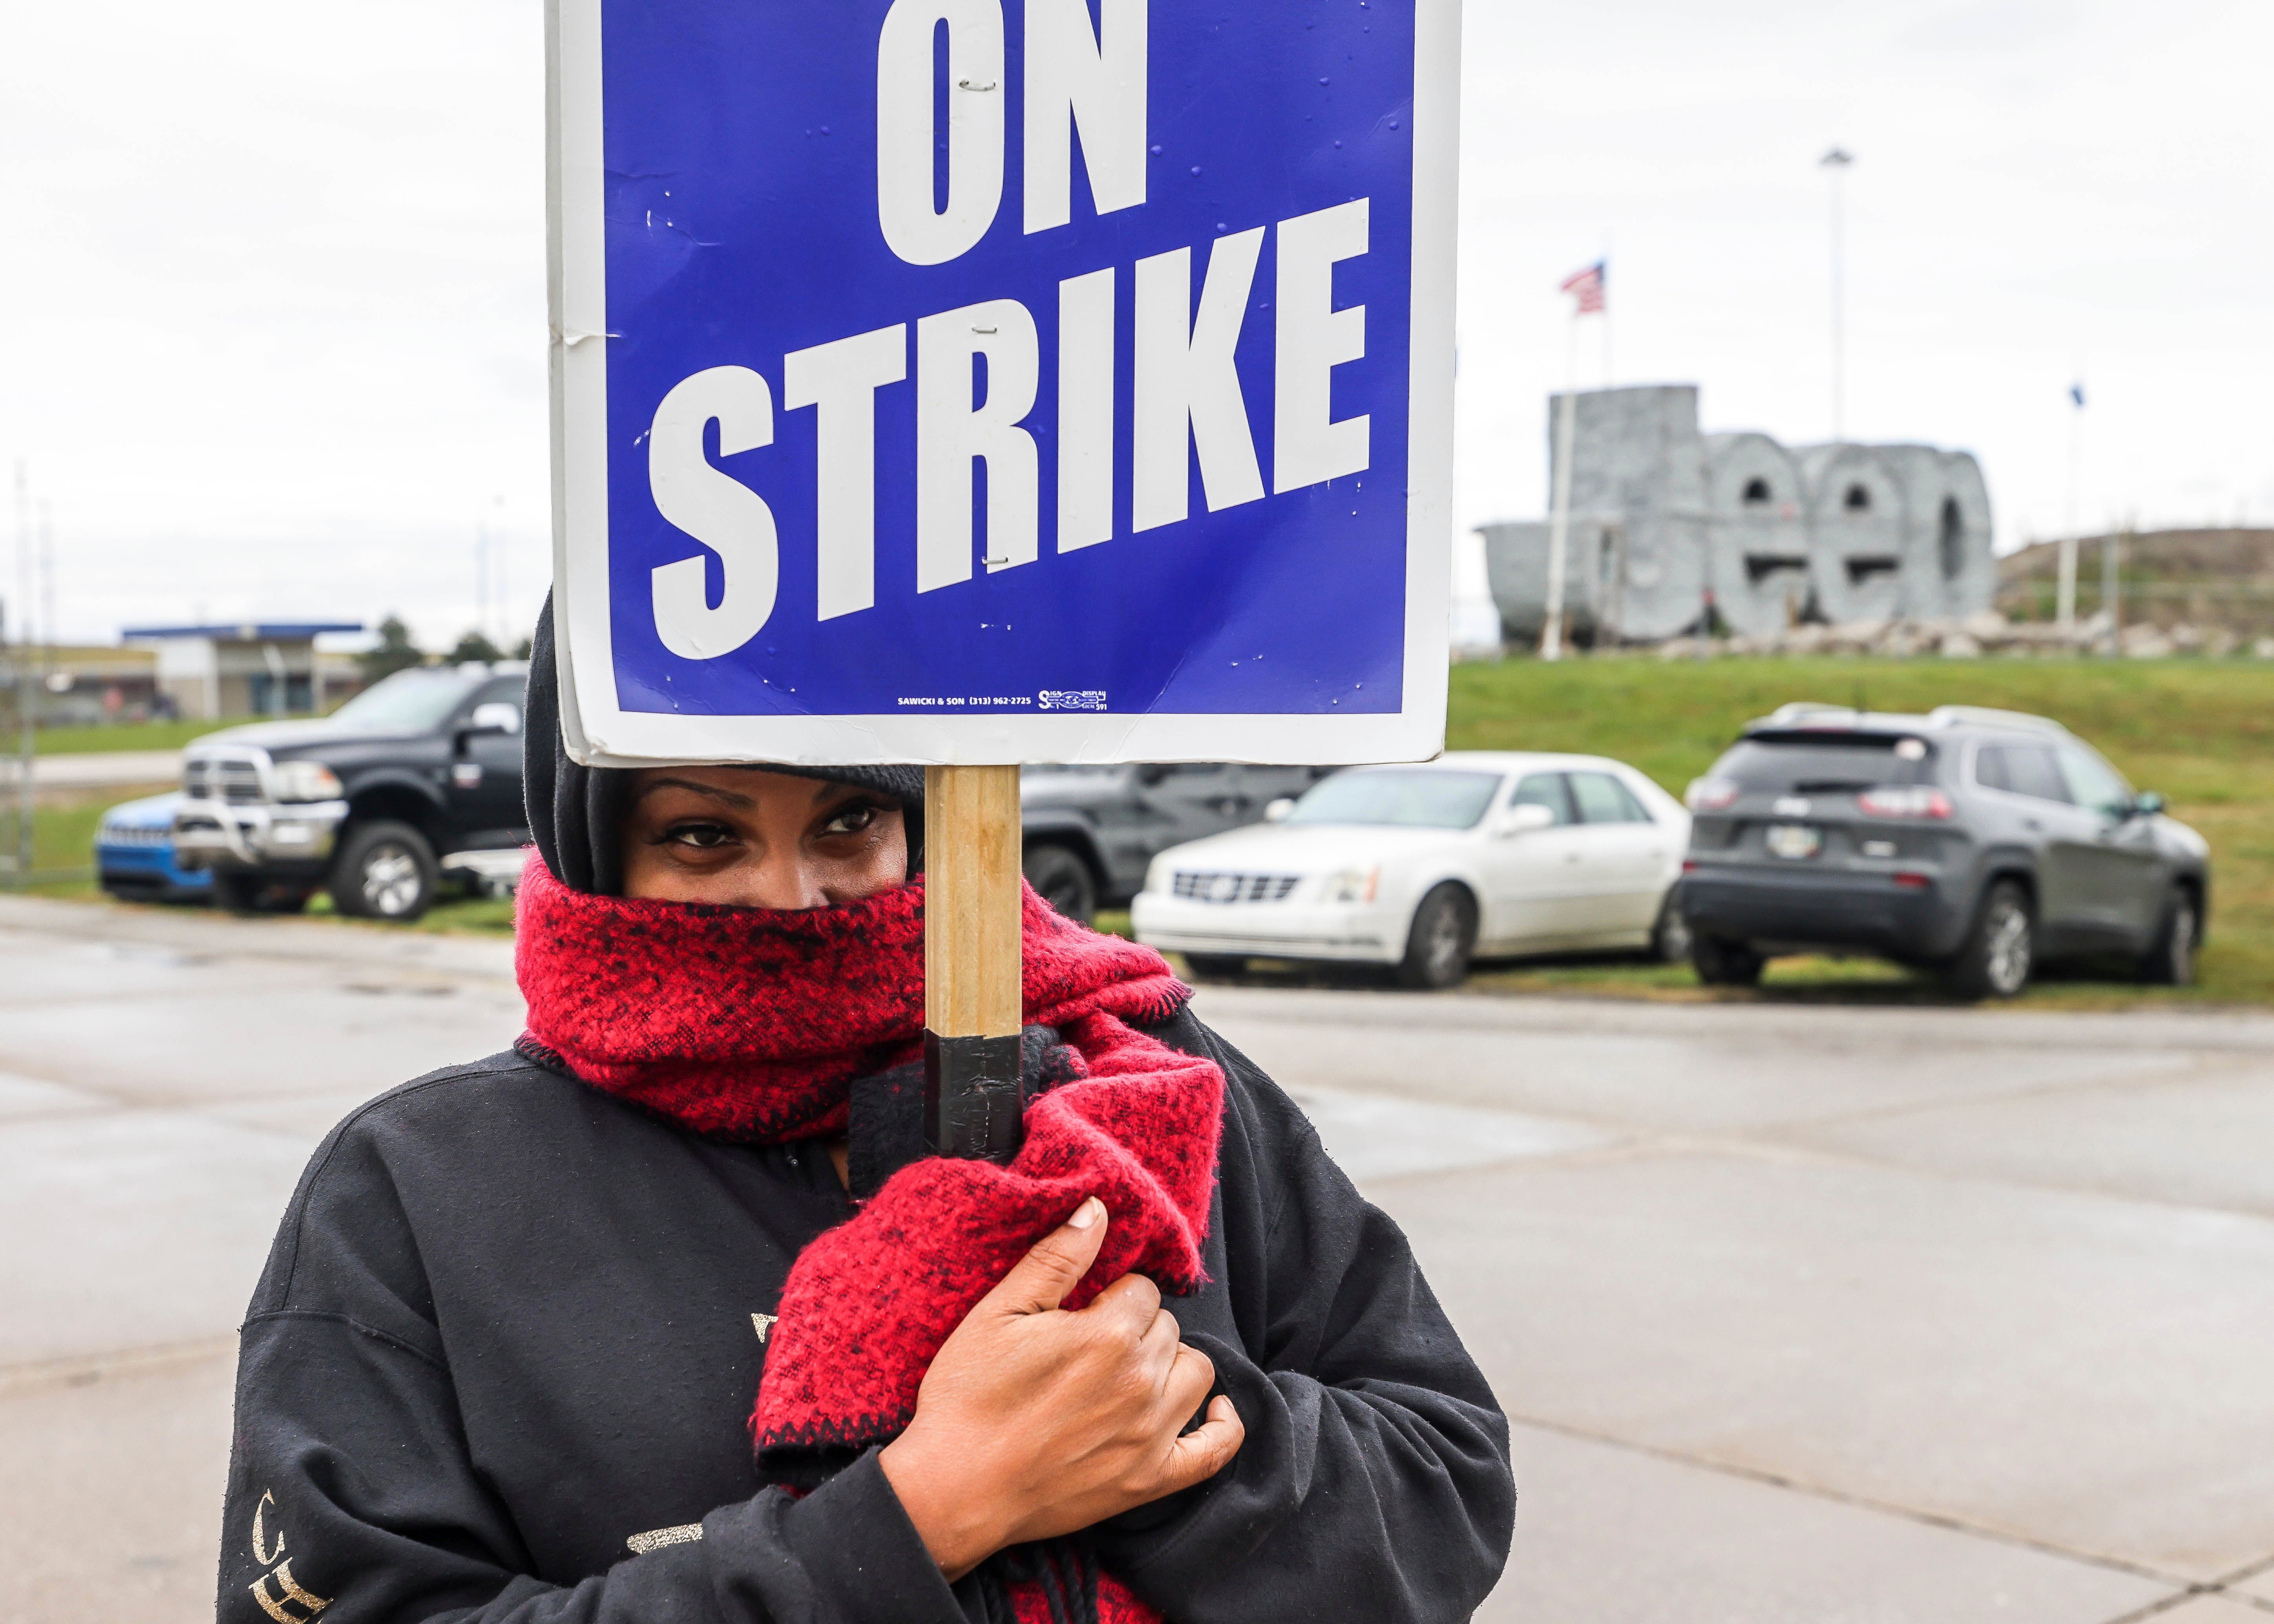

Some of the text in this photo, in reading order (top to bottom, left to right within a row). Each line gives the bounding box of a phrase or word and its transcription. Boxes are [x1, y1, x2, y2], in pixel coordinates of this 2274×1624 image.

[877, 0, 1148, 266] ON
[648, 197, 1370, 661] STRIKE
[969, 696, 991, 705] (313)
